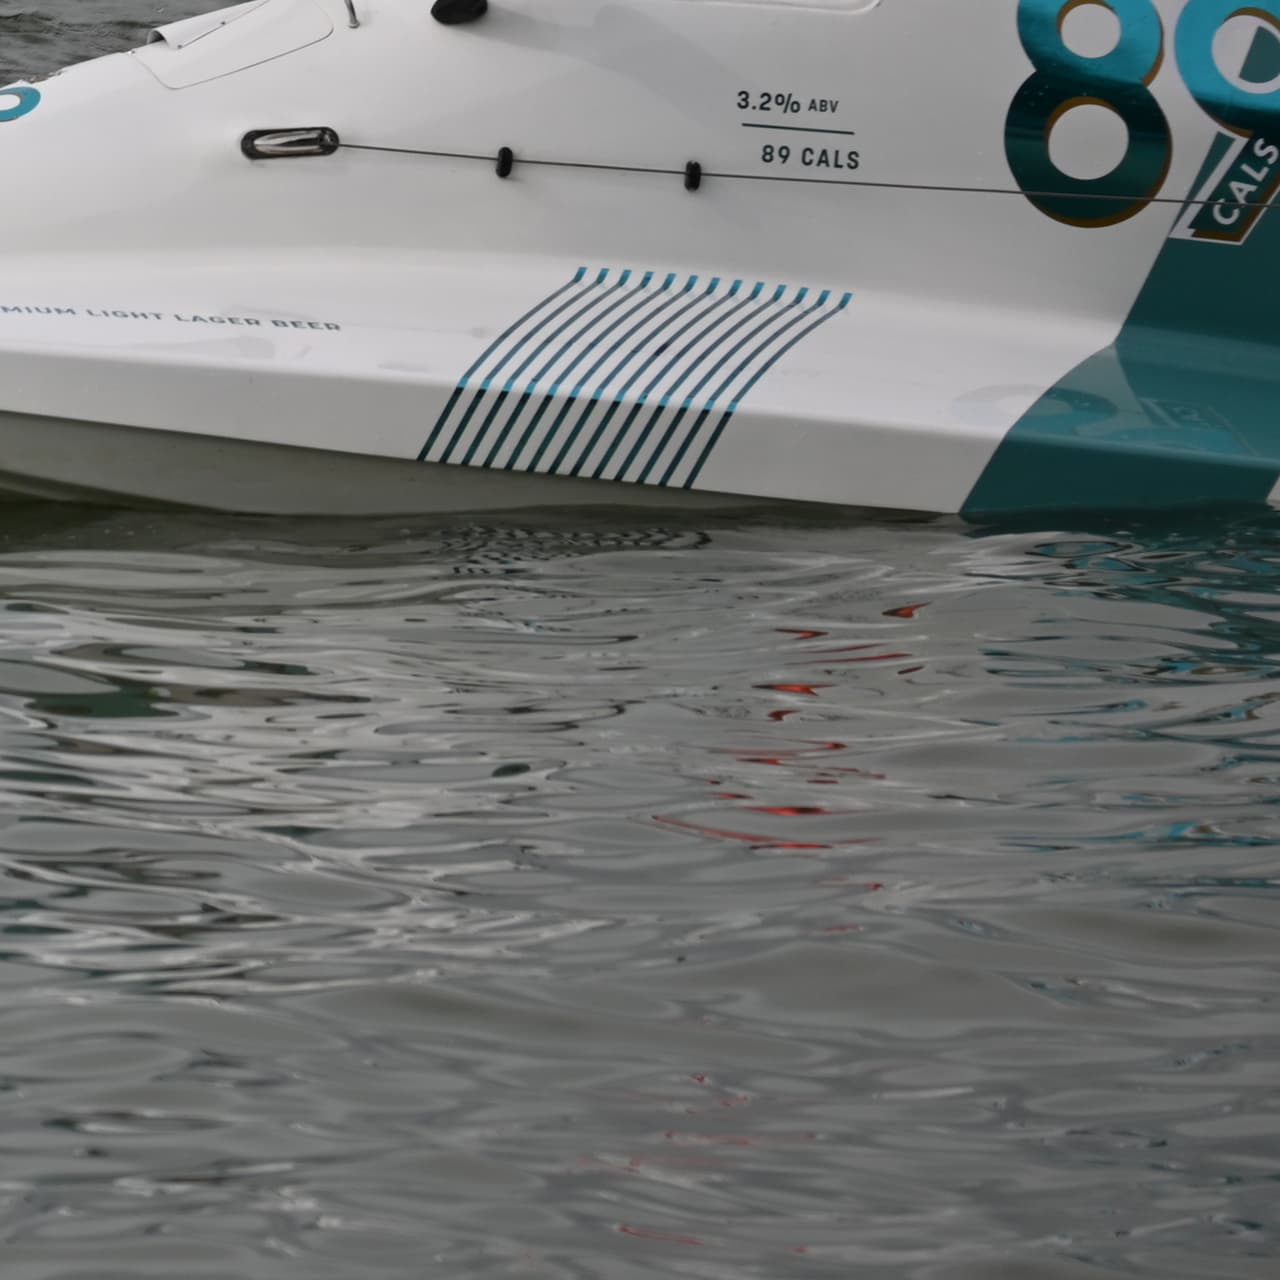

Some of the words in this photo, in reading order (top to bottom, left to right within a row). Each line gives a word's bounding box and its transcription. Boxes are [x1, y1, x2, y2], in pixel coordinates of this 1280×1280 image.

[736, 90, 801, 114] 3.2%
[807, 98, 839, 113] ABV
[761, 144, 791, 165] 89
[801, 147, 860, 170] CALS
[1213, 136, 1280, 225] CALS
[86, 308, 163, 321] LIGHT
[173, 313, 261, 326] LAGER
[271, 319, 341, 331] BEER
